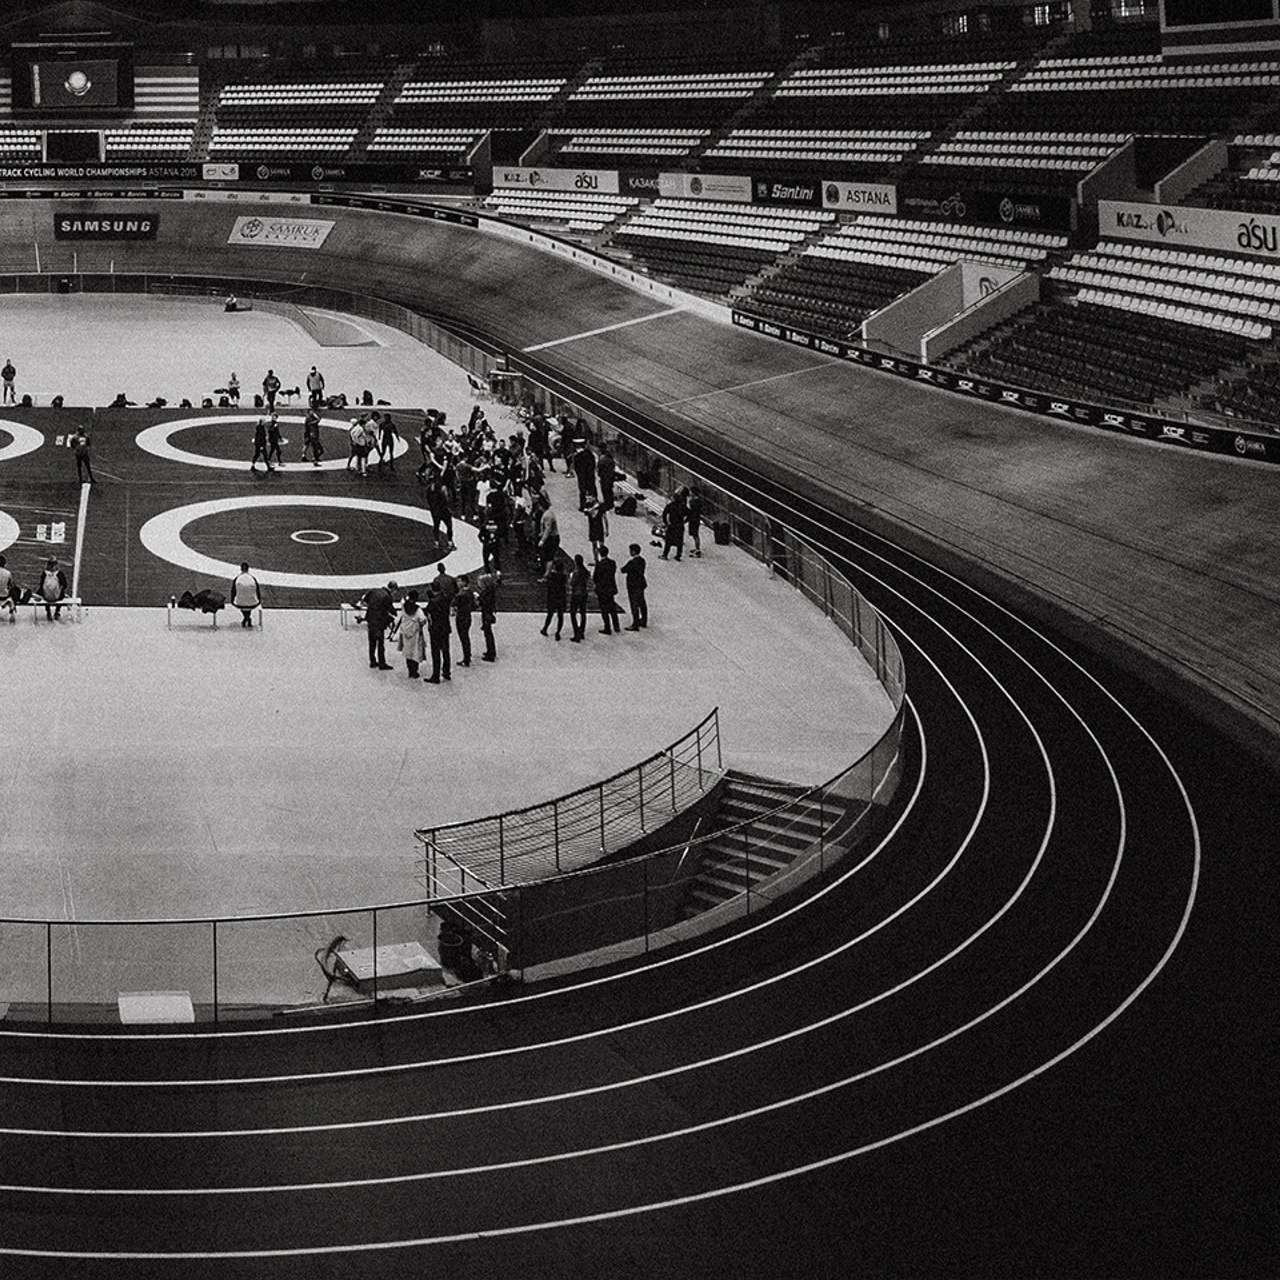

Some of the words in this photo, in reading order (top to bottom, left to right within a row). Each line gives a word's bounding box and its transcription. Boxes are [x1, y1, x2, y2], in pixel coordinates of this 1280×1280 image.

[24, 168, 55, 177] CYCLING
[57, 168, 84, 177] WORLD
[86, 167, 147, 177] CHAMPIONSHIPS
[771, 184, 814, 200] Santini
[846, 190, 891, 206] ASTANA
[61, 221, 151, 232] SAMSUNG
[269, 224, 321, 236] SAMRUK
